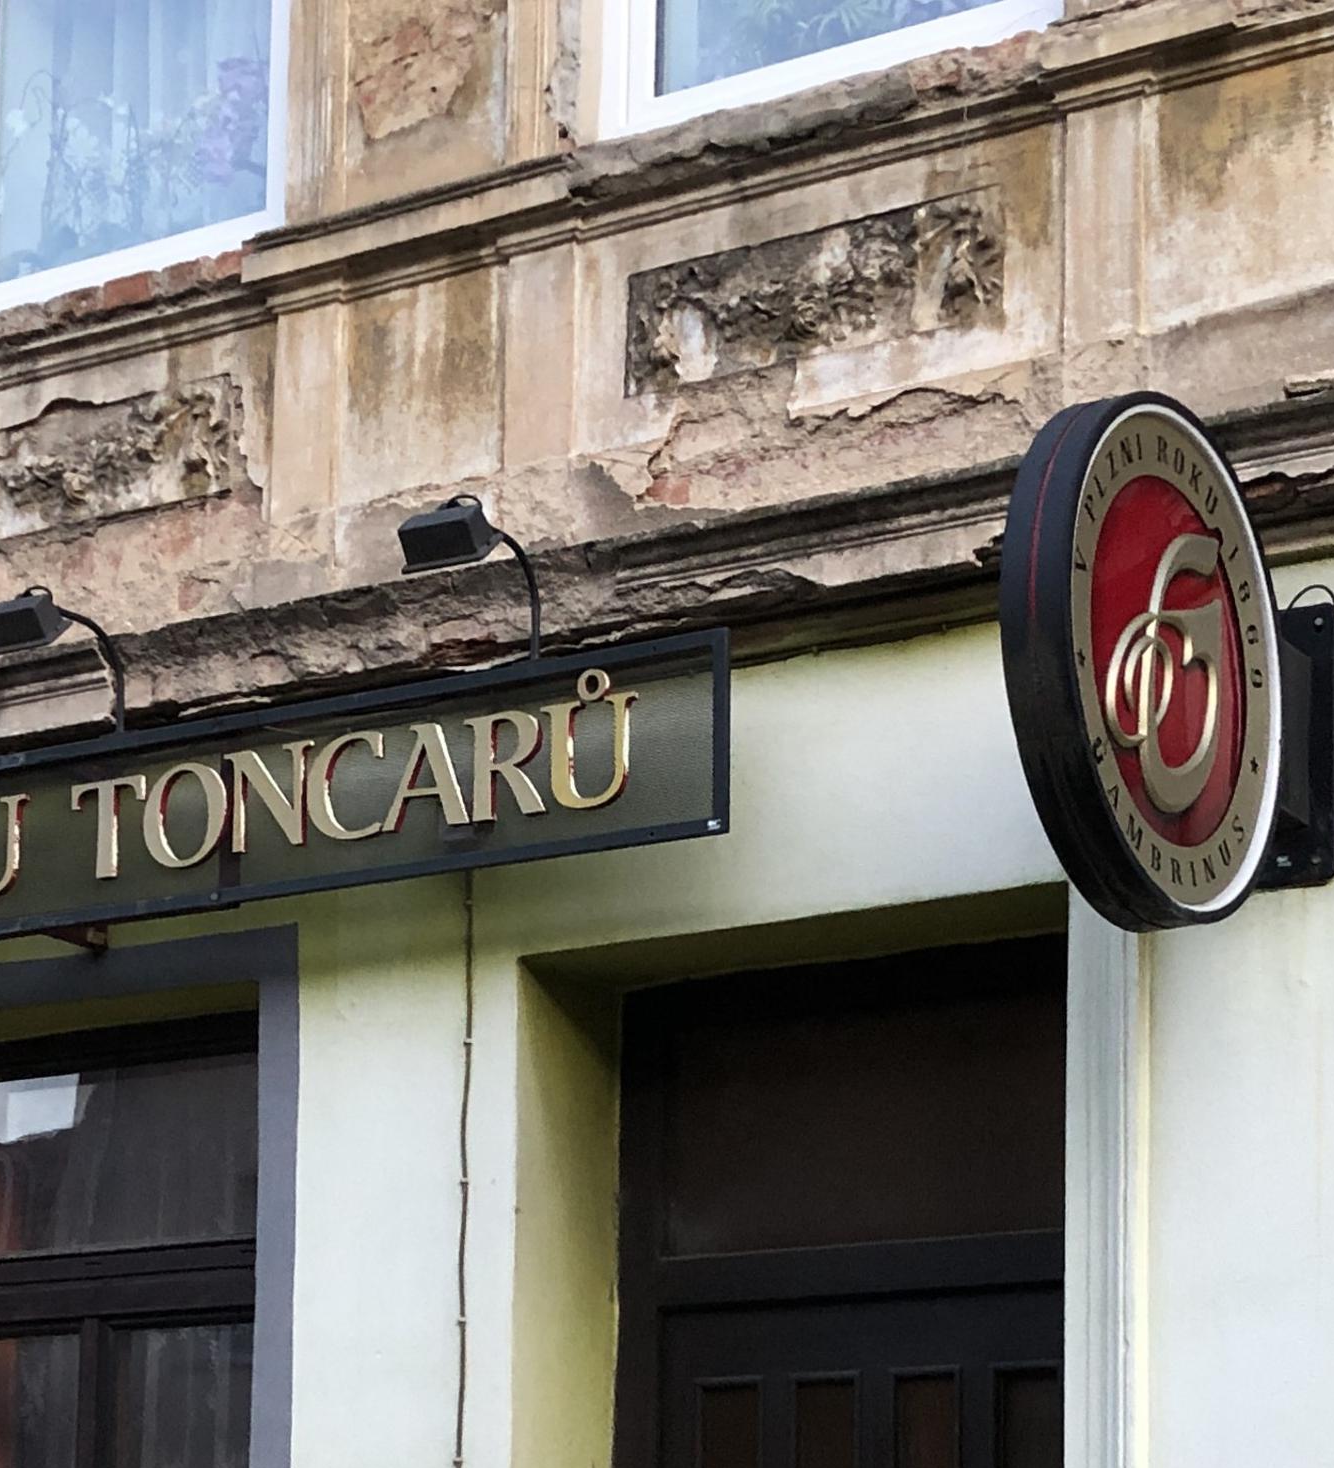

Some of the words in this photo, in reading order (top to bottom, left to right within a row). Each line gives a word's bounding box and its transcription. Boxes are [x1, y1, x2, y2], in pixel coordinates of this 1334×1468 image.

[1074, 544, 1088, 572] V
[1083, 432, 1143, 524] PLZNI
[1156, 434, 1219, 515] ROKU
[71, 667, 639, 880] TONCARŮ
[1091, 735, 1246, 888] GAMBRINUS
